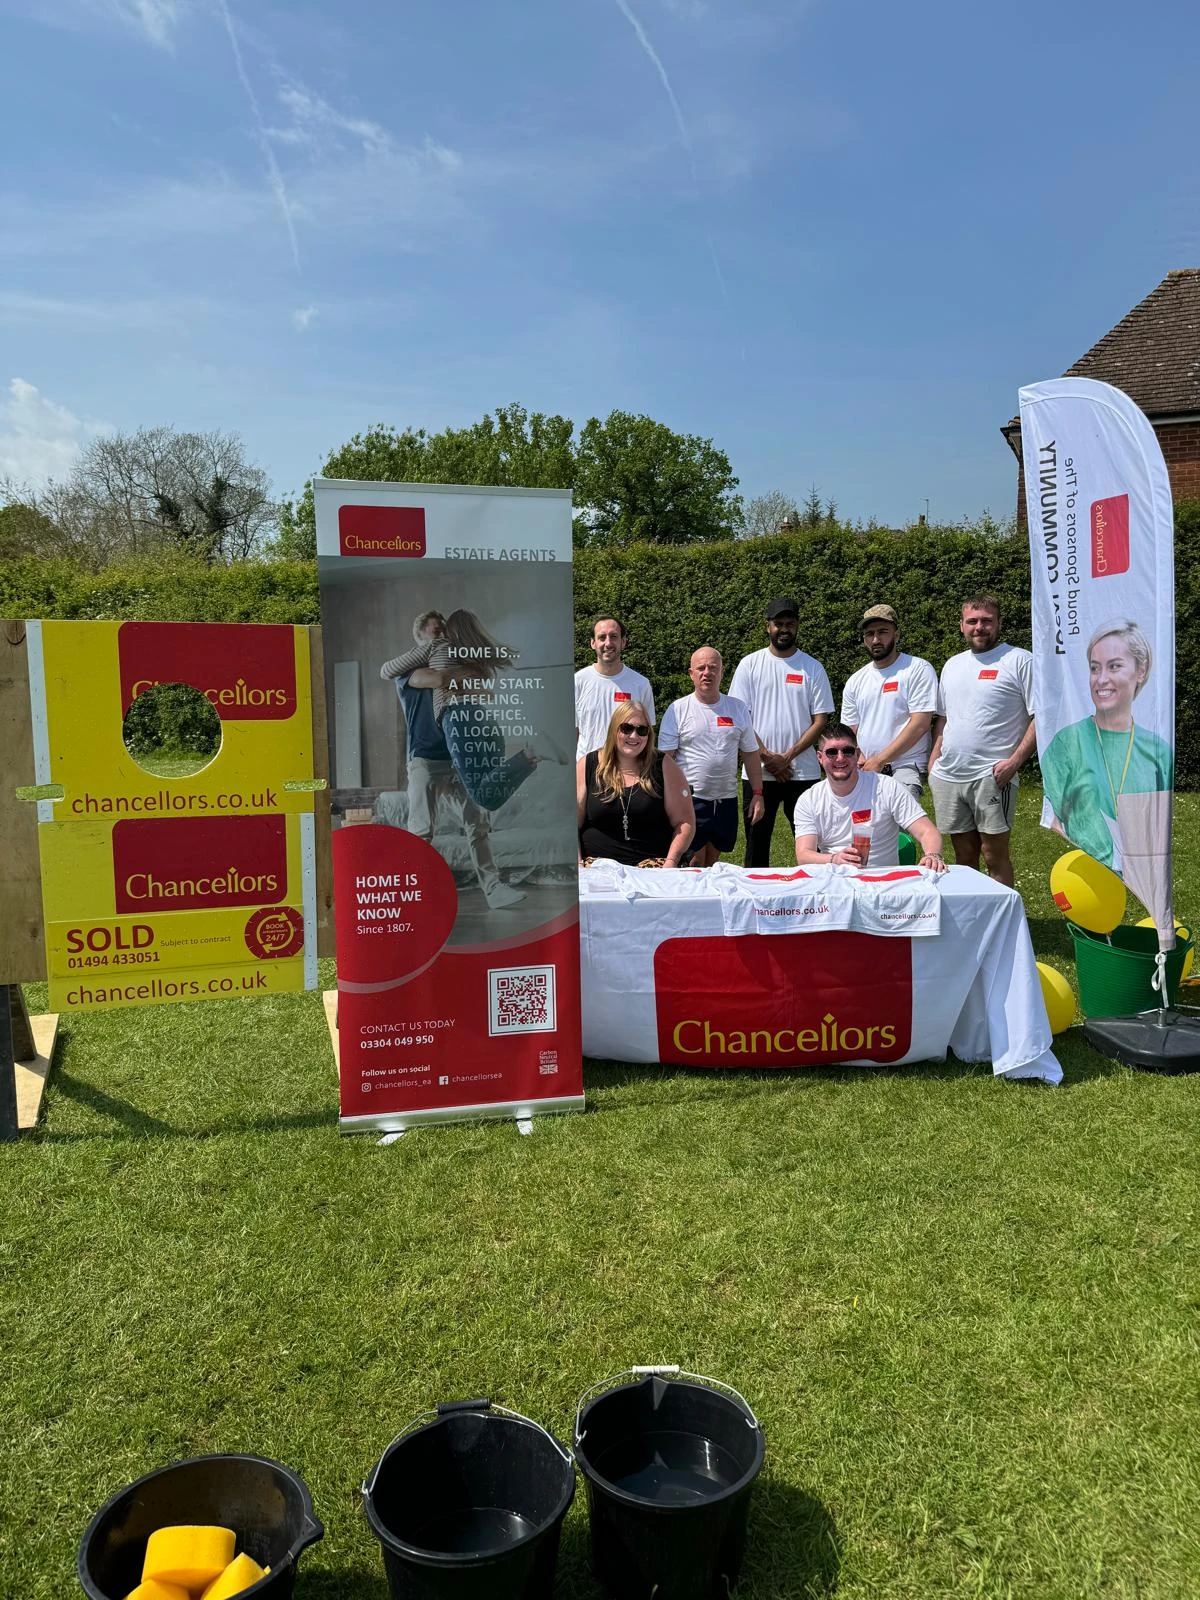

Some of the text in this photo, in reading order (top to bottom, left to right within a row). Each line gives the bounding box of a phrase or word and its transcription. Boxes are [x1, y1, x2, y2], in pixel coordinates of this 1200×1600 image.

[344, 534, 422, 552] Chancellors
[444, 546, 556, 562] ESTATE AGENTS
[448, 646, 521, 659] HOME IS...
[448, 678, 545, 690] A NEW START.
[132, 678, 287, 706] Ccellors
[449, 693, 524, 706] A FEELING.
[449, 709, 526, 722] AN OFFICE.
[450, 725, 539, 738] A LOCATION.
[450, 741, 501, 754] A GYM.
[451, 756, 511, 769] A PLACE.
[451, 772, 511, 785] A SPACE.
[71, 787, 278, 814] chancellors.co.uk
[126, 867, 278, 900] Chancellors
[356, 873, 418, 888] HOME IS
[356, 890, 422, 904] WHAT WE
[357, 907, 401, 921] KNOW
[752, 904, 830, 916] hancellors.co.uk
[880, 912, 937, 920] chancellors.co.uk
[357, 922, 414, 935] Since 1807.
[66, 924, 155, 954] SOLD
[160, 935, 231, 947] Subject to contract
[265, 933, 286, 942] 24/7
[67, 951, 160, 969] 01494 433051
[66, 970, 268, 1005] chancellors.co.uk
[360, 1018, 456, 1035] CONTACT US TODAY
[672, 1012, 897, 1054] Chancellors
[360, 1034, 434, 1049] 03304 049 950
[361, 1069, 387, 1078] Follow
[398, 1066, 408, 1074] on
[409, 1064, 431, 1073] social
